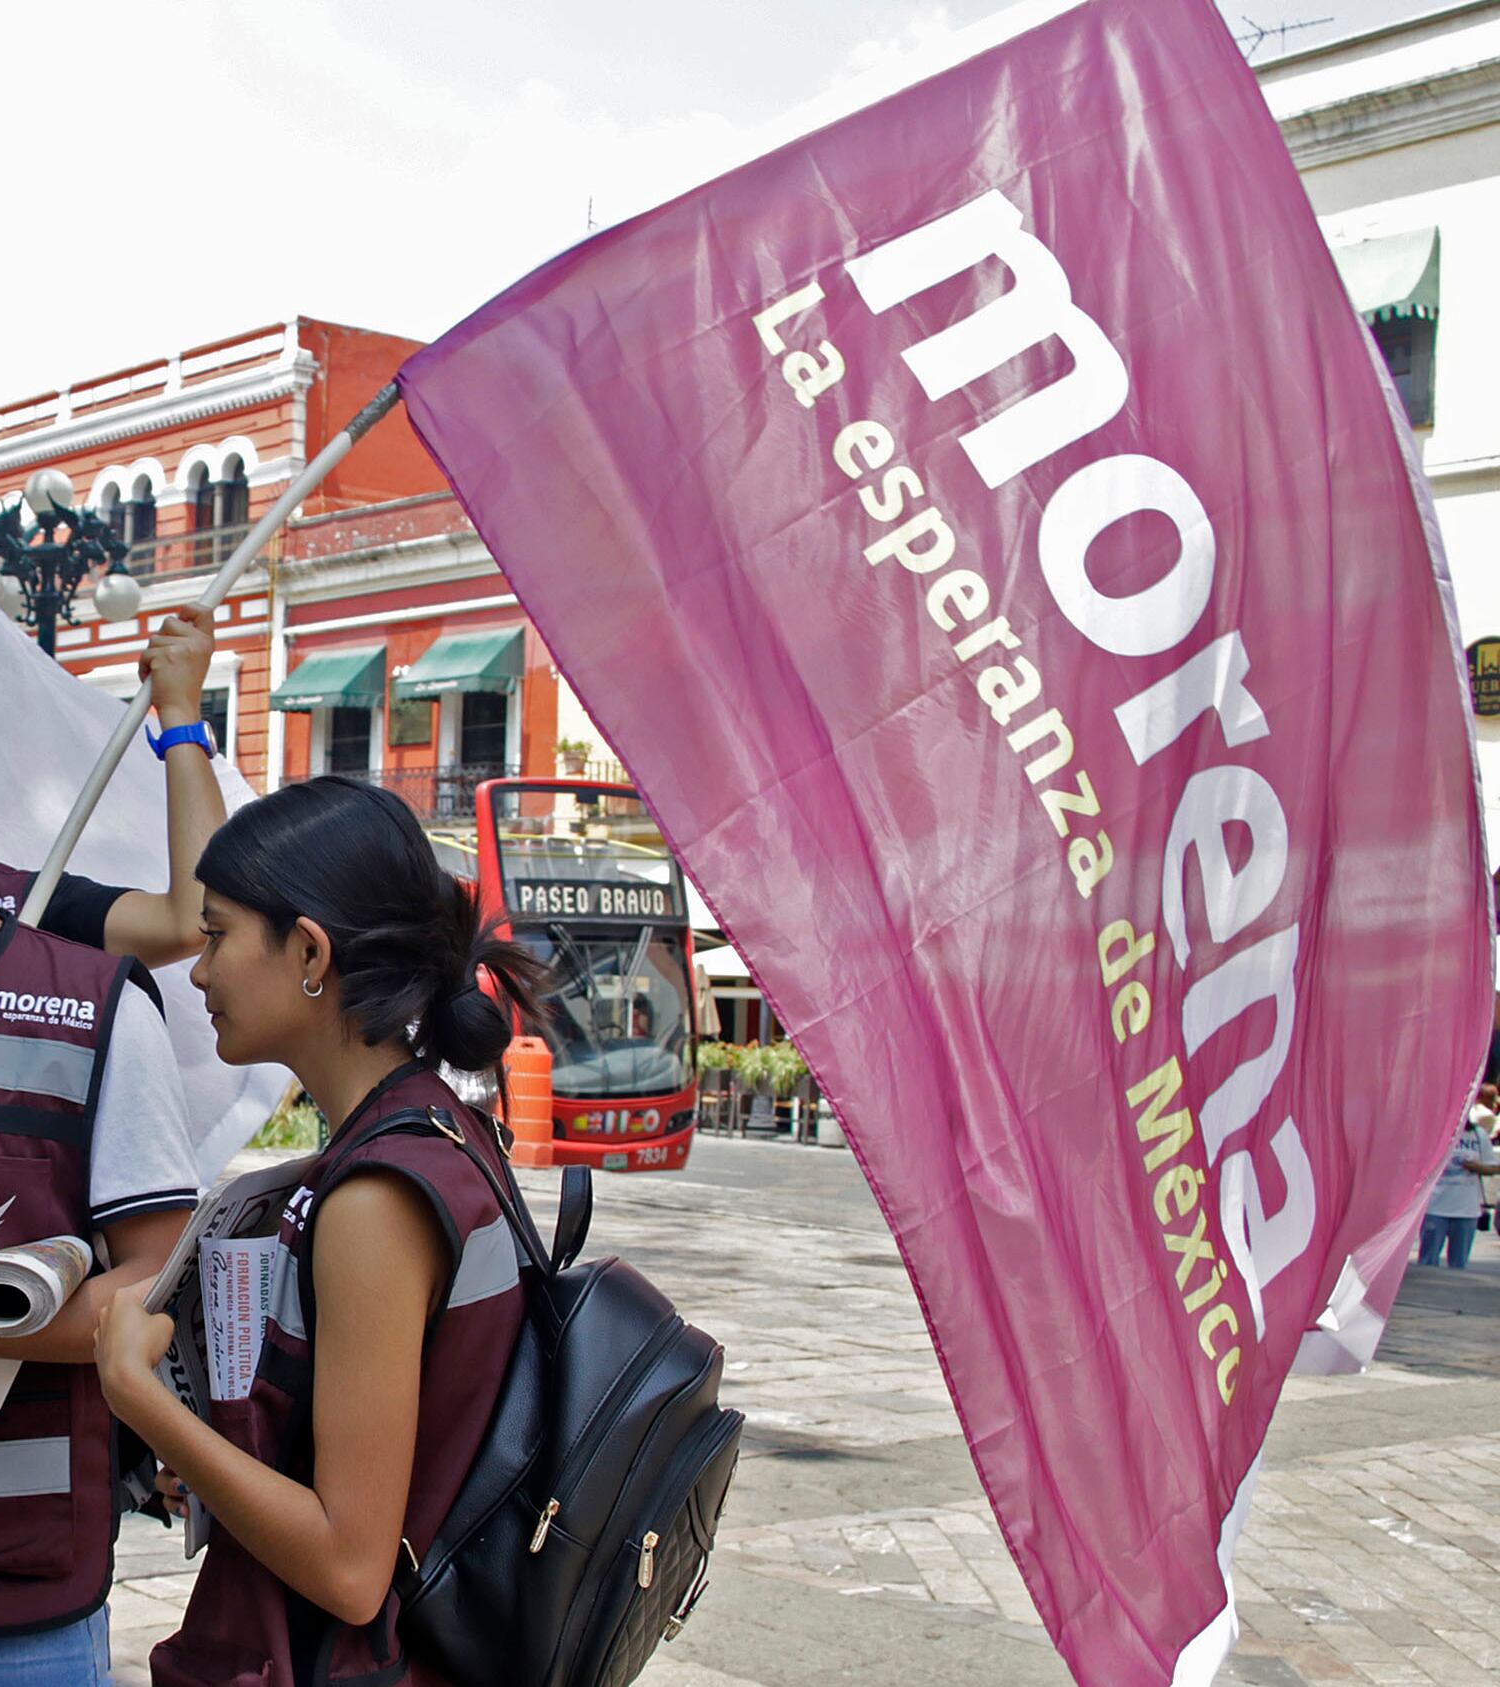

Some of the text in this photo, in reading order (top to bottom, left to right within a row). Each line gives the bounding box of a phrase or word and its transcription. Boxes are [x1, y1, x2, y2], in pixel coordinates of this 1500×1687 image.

[752, 281, 846, 409] La
[833, 419, 1116, 900] esperanza
[1096, 918, 1156, 1045] de
[845, 187, 1316, 1343] morena
[520, 885, 665, 916] PASEO BRAVO
[2, 1011, 46, 1023] esperanza
[47, 1015, 60, 1025] de
[60, 1016, 94, 1030] México
[236, 1251, 253, 1380] FORMACIÓN POLÍTICA
[259, 1252, 270, 1312] JORNADAS
